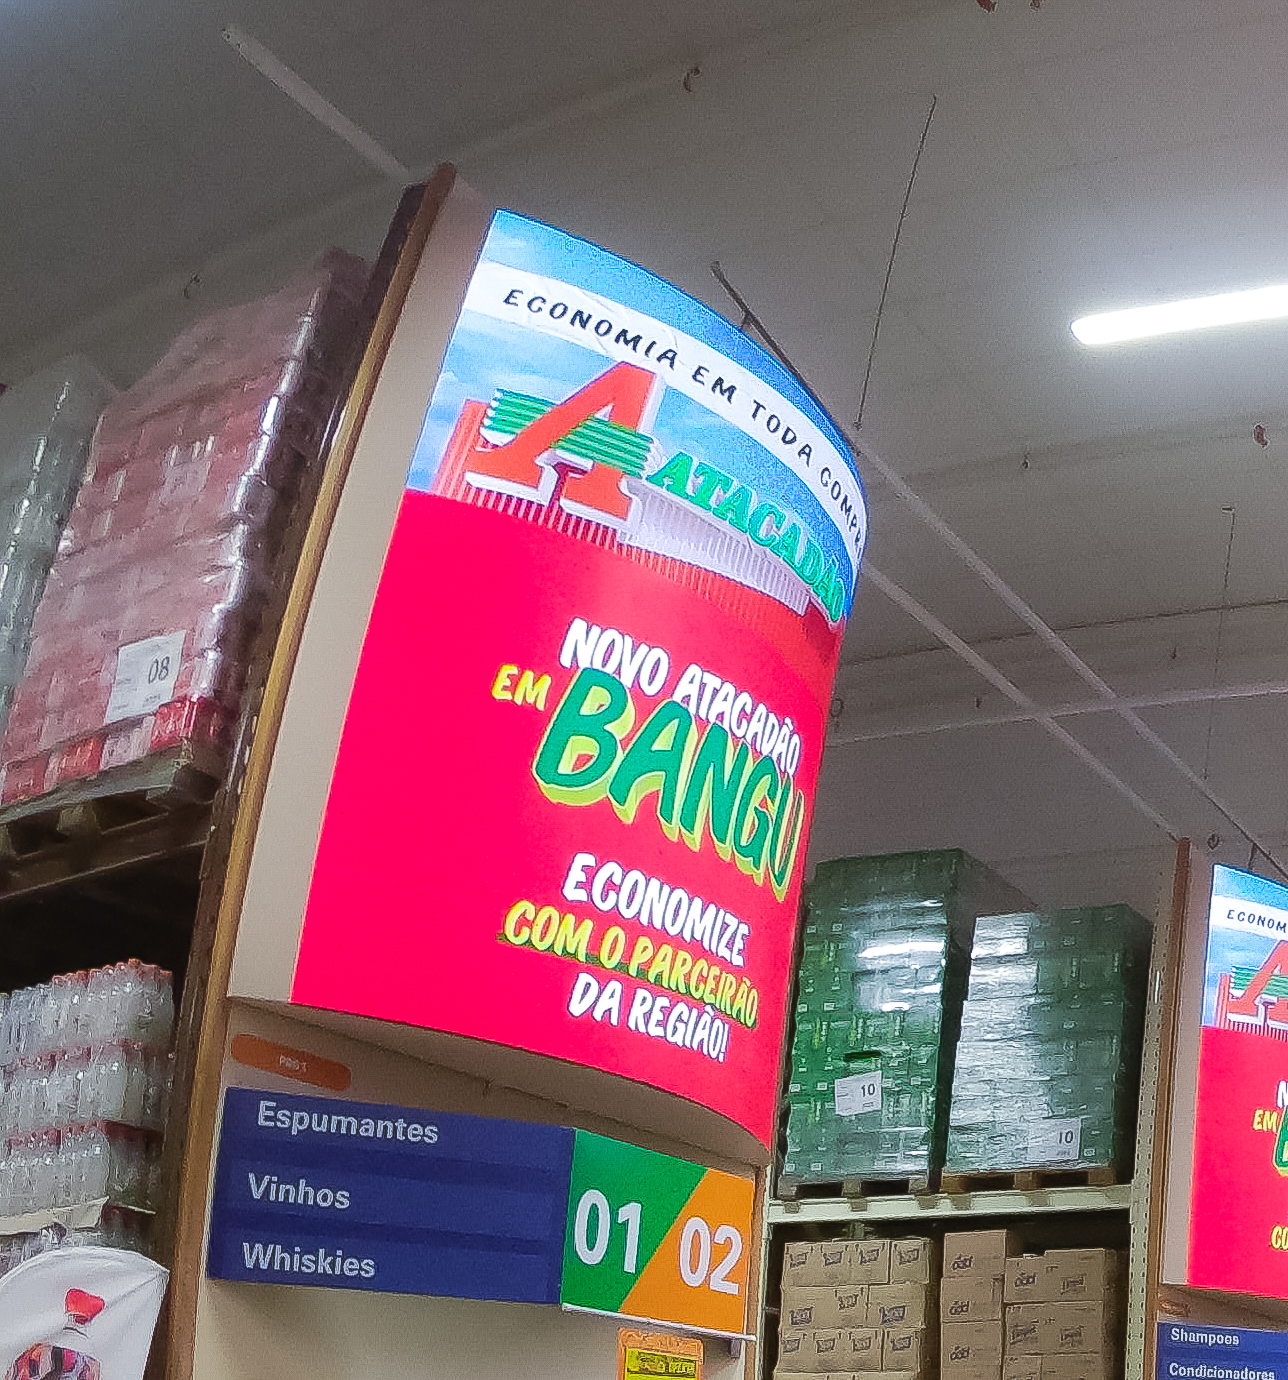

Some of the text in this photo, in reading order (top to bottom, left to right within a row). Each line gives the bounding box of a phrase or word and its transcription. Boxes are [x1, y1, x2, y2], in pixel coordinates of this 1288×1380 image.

[504, 289, 863, 549] ECONOMIA EM TODA COMPR
[146, 655, 171, 684] 08
[560, 618, 801, 777] NOVO ATACADÃO
[491, 664, 805, 902] EM BANGU
[562, 852, 750, 967] ECONOMIZE
[503, 900, 759, 1029] COM O PARCEIRÃO
[568, 972, 731, 1062] DA REGIÃO!
[860, 1083, 876, 1099] 10
[257, 1100, 439, 1144] Espumantes
[1058, 1130, 1074, 1145] 10
[1253, 1109, 1278, 1132] EM
[248, 1172, 351, 1210] Vinhos
[242, 1242, 376, 1278] Whiskies
[573, 1189, 744, 1296] 01 02
[1170, 1327, 1240, 1346] Shampoos
